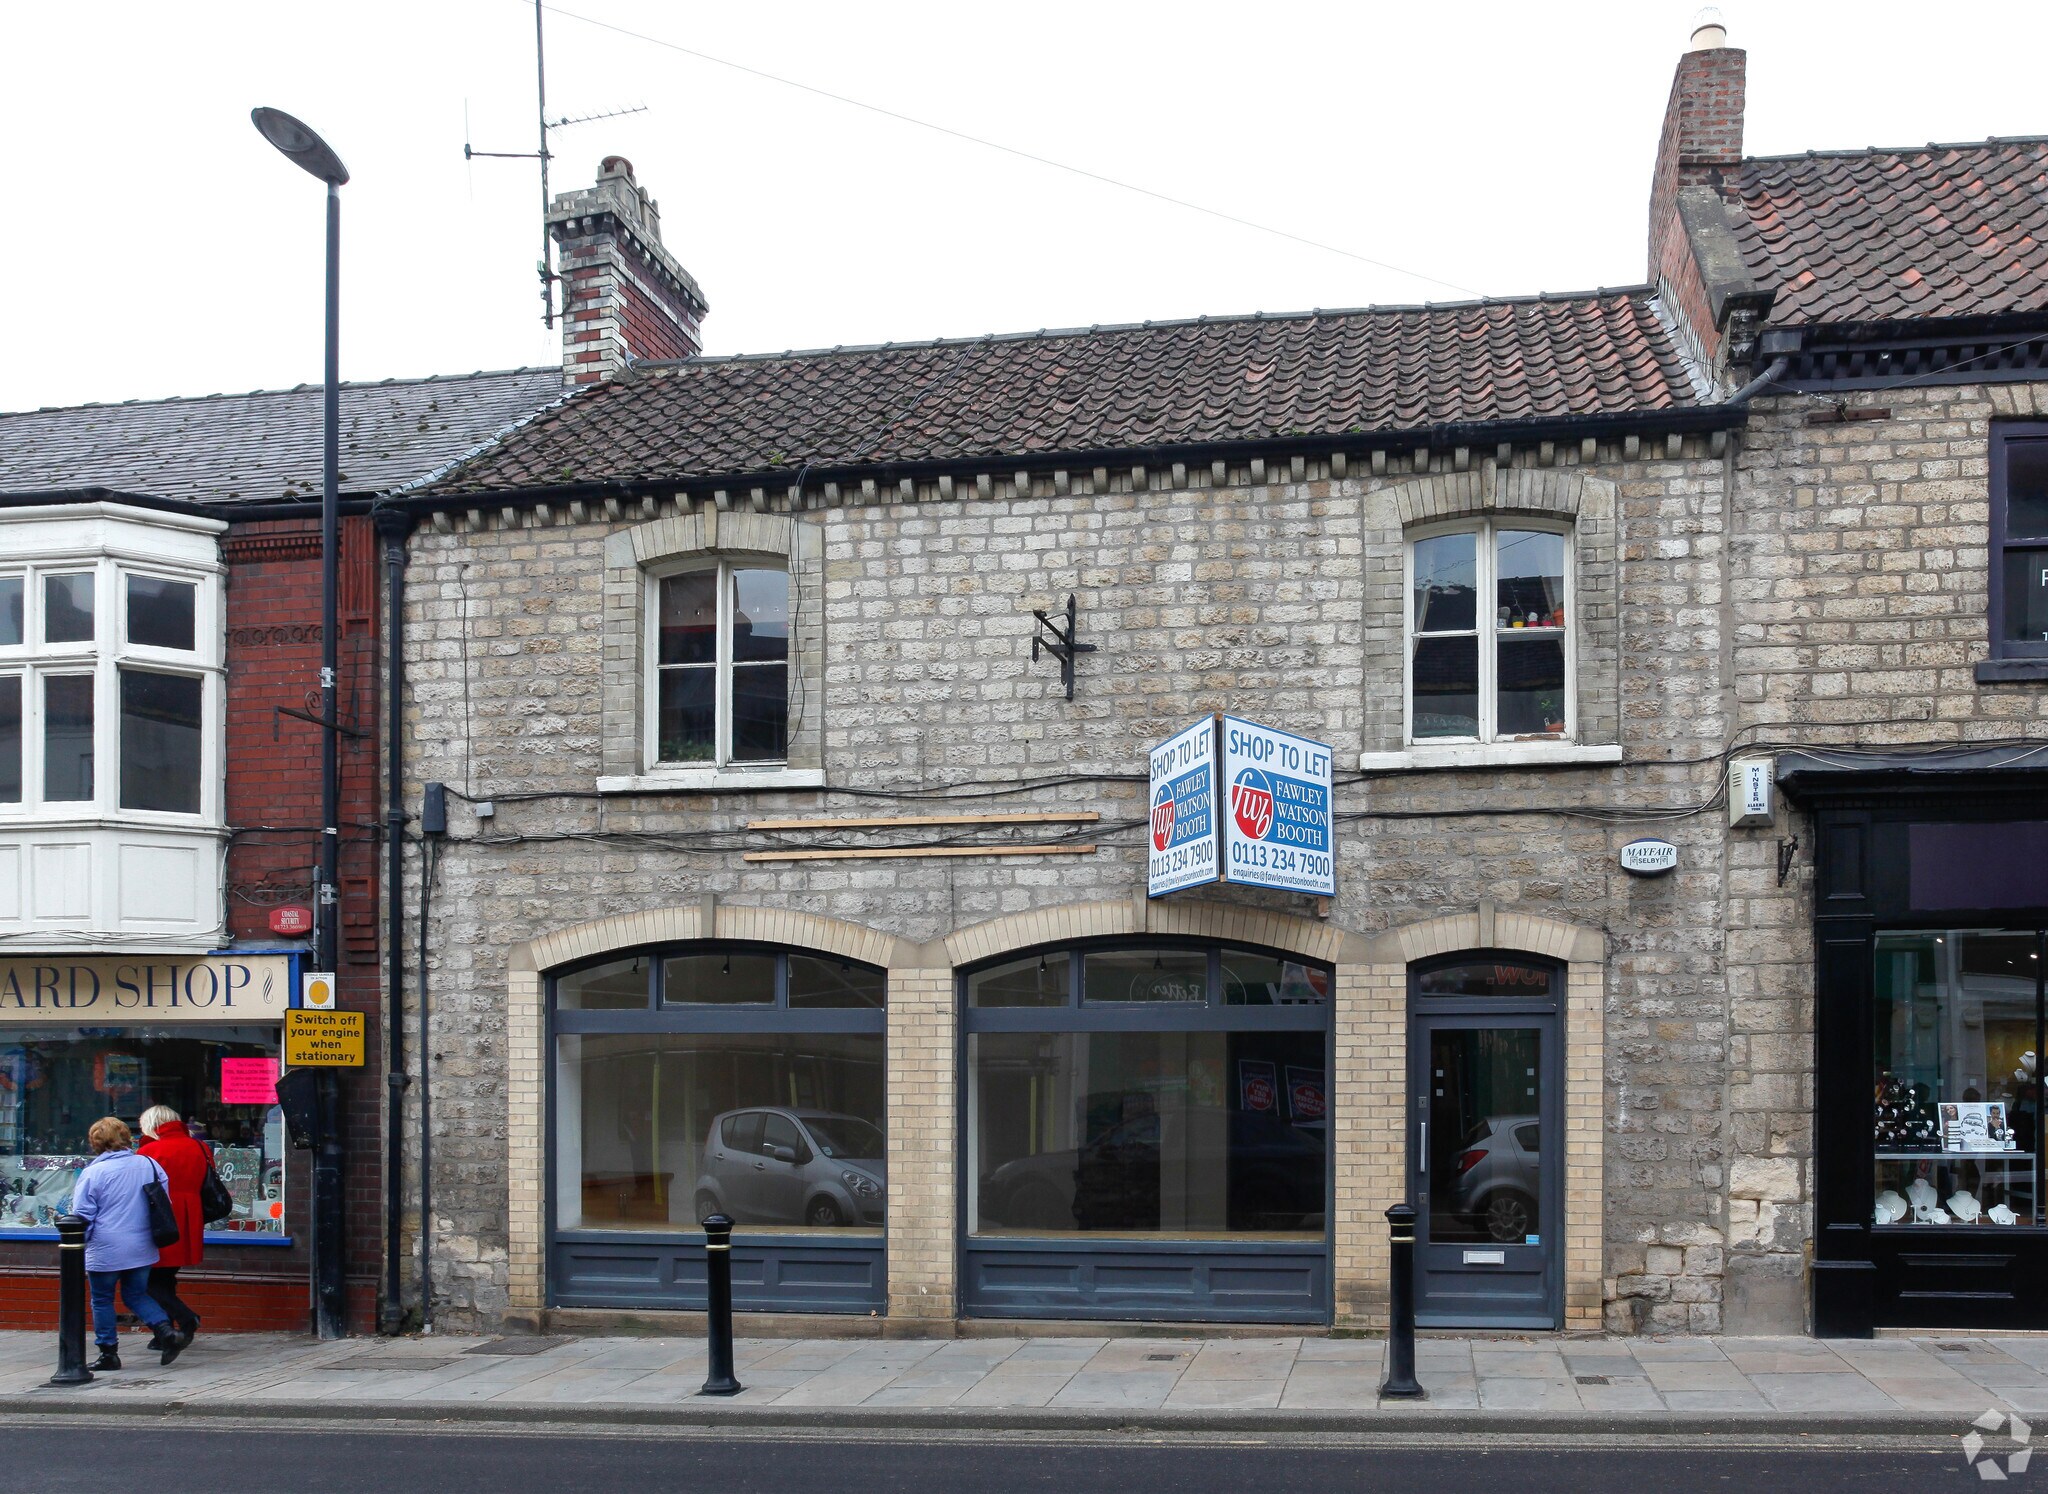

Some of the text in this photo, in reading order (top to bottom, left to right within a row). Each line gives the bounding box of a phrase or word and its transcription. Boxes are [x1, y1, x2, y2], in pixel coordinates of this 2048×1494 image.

[1151, 727, 1211, 782] SHOP TO LET
[1229, 729, 1329, 778] SHOP TO LET
[1176, 769, 1208, 799] FAWLEY
[1275, 780, 1324, 806] FAWLEY
[1751, 767, 1760, 802] MINSTER
[1176, 790, 1210, 819] WATSON
[1275, 801, 1328, 828] WATSON
[1176, 814, 1207, 840] BOOTH
[1276, 822, 1323, 847] BOOTH
[1151, 839, 1213, 879] 0113 234 7900
[1232, 841, 1330, 877] 0113 234 7900
[1626, 847, 1673, 857] MAYFAIR
[1150, 866, 1214, 891] enquiries@fawleywatsonbooth.com
[1232, 868, 1331, 895] enquiries@fawleywatsonbooth.com
[280, 917, 300, 925] SECURITY
[114, 964, 251, 1008] SHOP
[294, 1013, 357, 1025] Switch off
[291, 1027, 360, 1039] your engine
[310, 1039, 342, 1049] when
[295, 1051, 356, 1063] stationary
